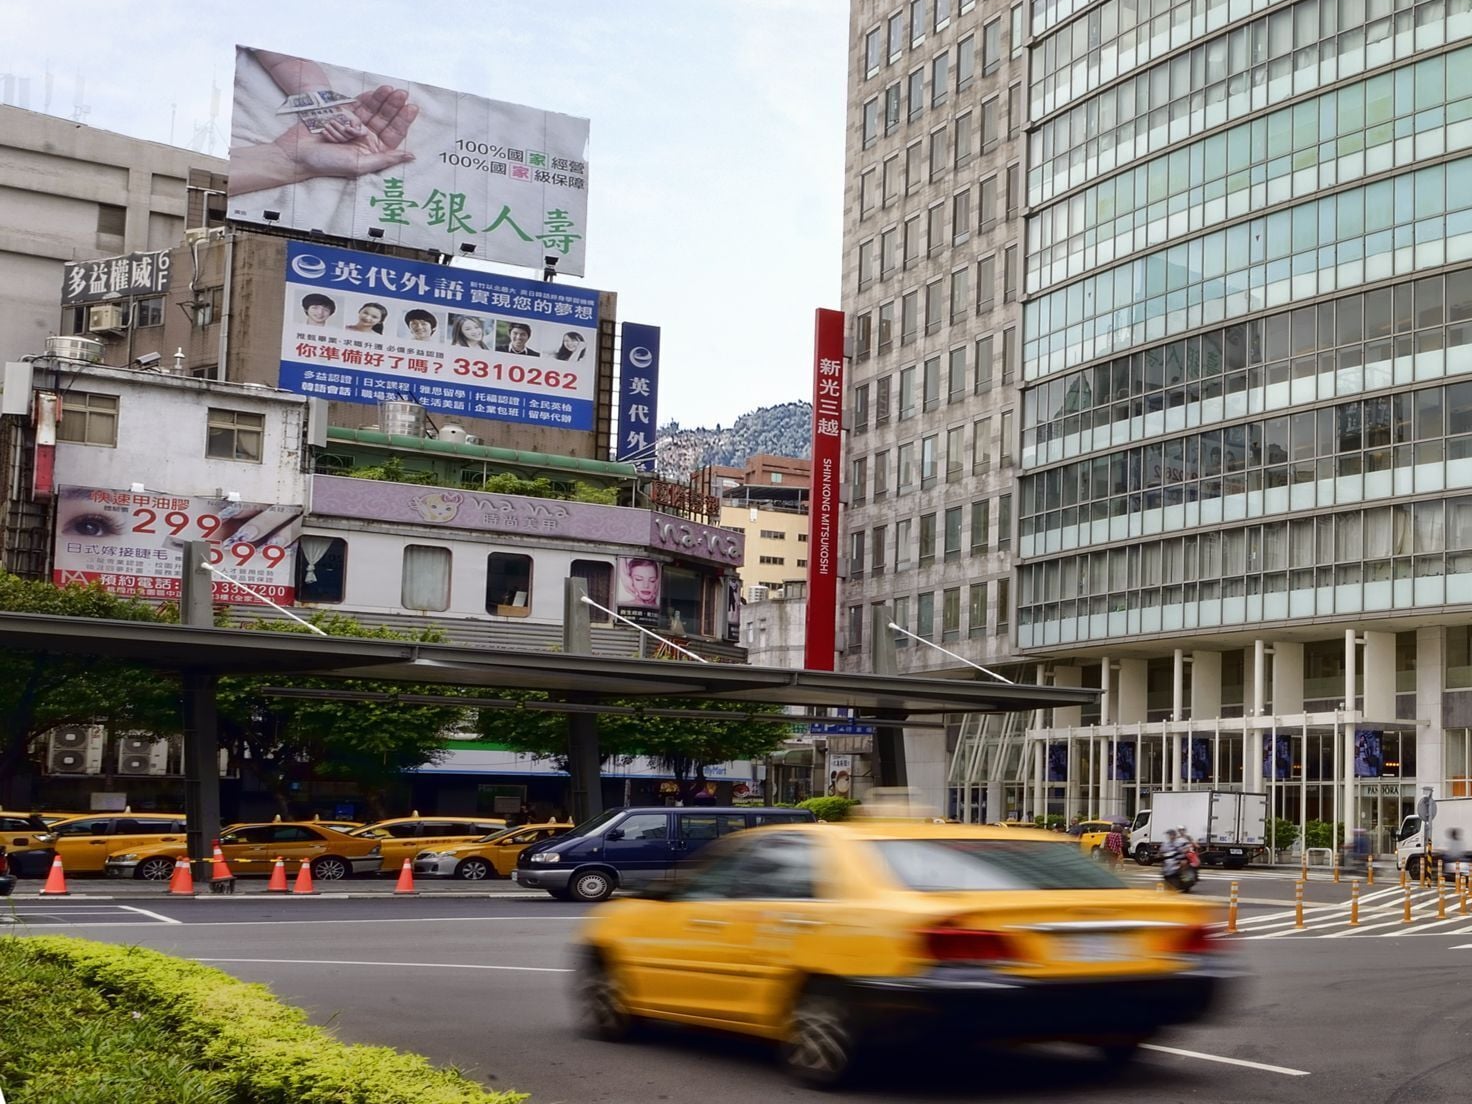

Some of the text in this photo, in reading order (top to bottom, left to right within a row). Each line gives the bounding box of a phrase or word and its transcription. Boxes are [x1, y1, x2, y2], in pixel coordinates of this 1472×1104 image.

[369, 177, 582, 254] 臺銀人壽
[68, 257, 152, 297] 多益權威
[331, 261, 464, 300] 英代外語
[470, 289, 593, 320] 實現您的夢想
[453, 358, 578, 390] 3310262
[817, 357, 842, 437] 新光三越
[131, 508, 222, 538] 299
[820, 458, 832, 575] SHIN KONG MITSUKOSHI
[67, 542, 169, 561] 日式嫁接睫毛
